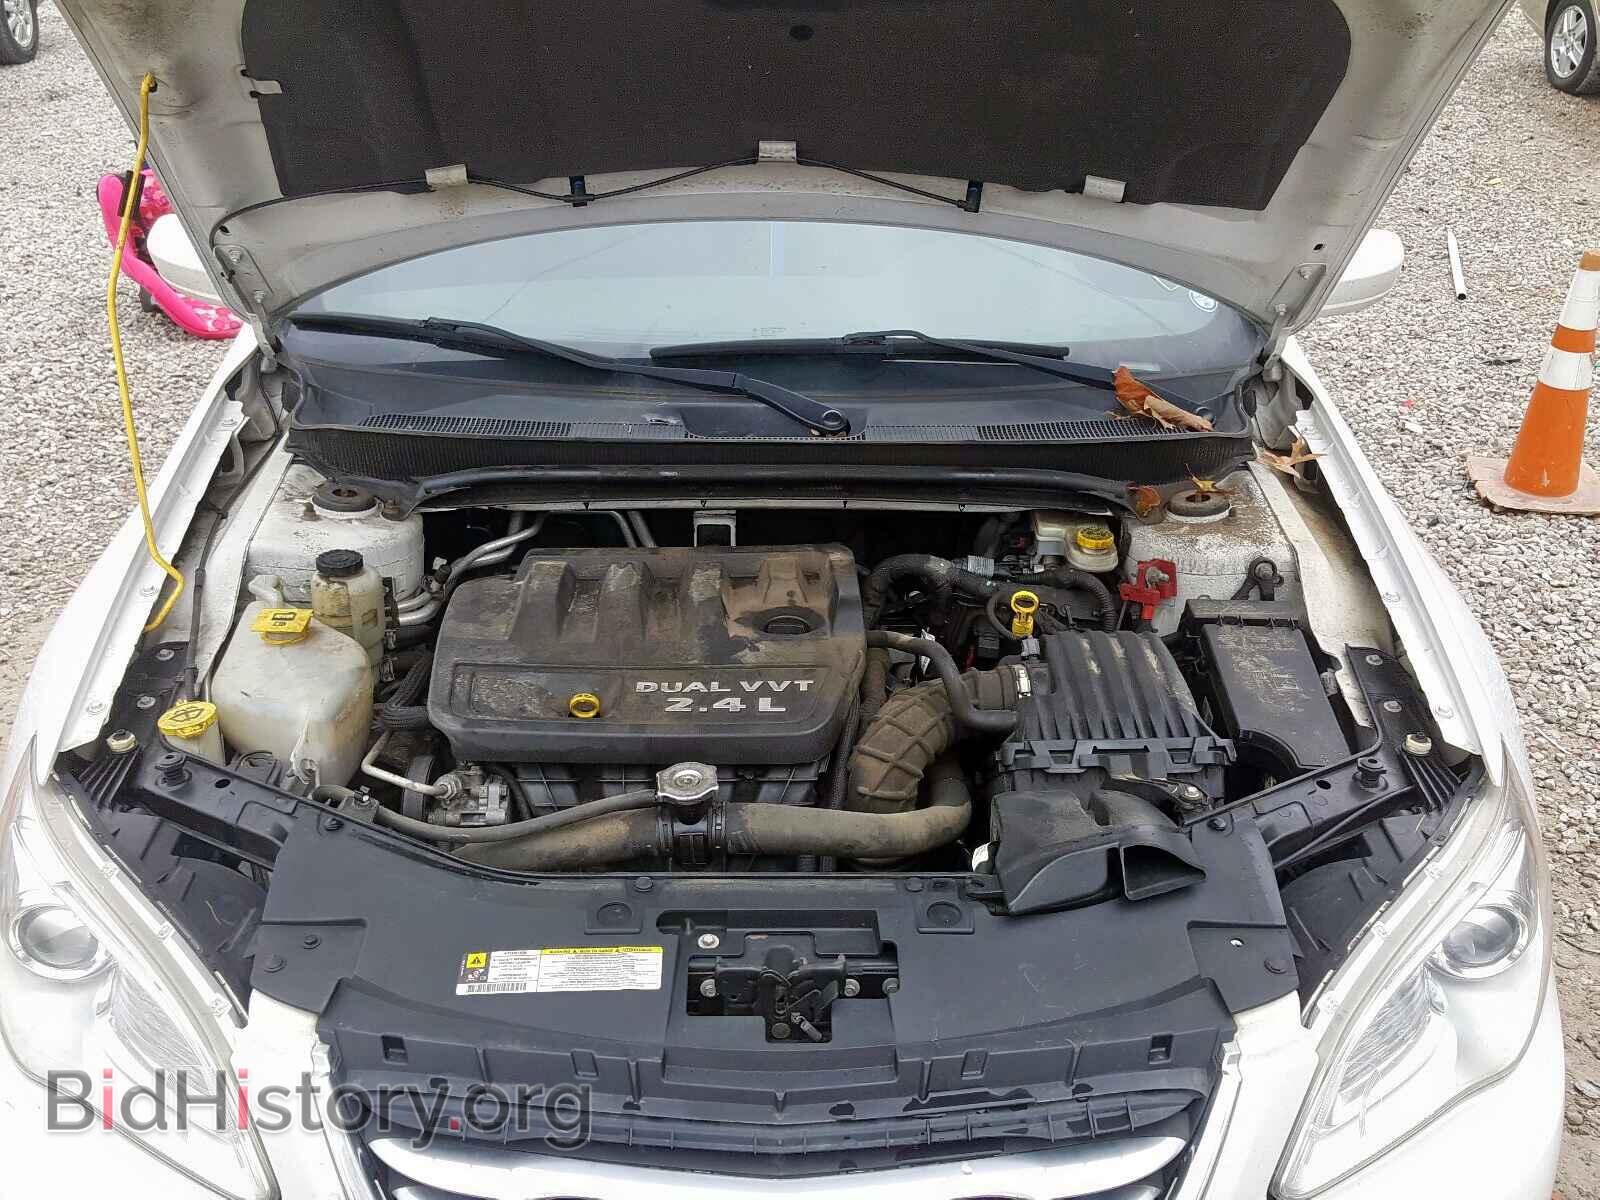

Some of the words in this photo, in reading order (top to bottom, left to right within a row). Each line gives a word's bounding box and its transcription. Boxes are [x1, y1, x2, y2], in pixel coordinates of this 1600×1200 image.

[635, 680, 731, 694] DUAL
[738, 679, 815, 693] VVT
[665, 697, 747, 712] 2.4
[758, 697, 787, 712] L
